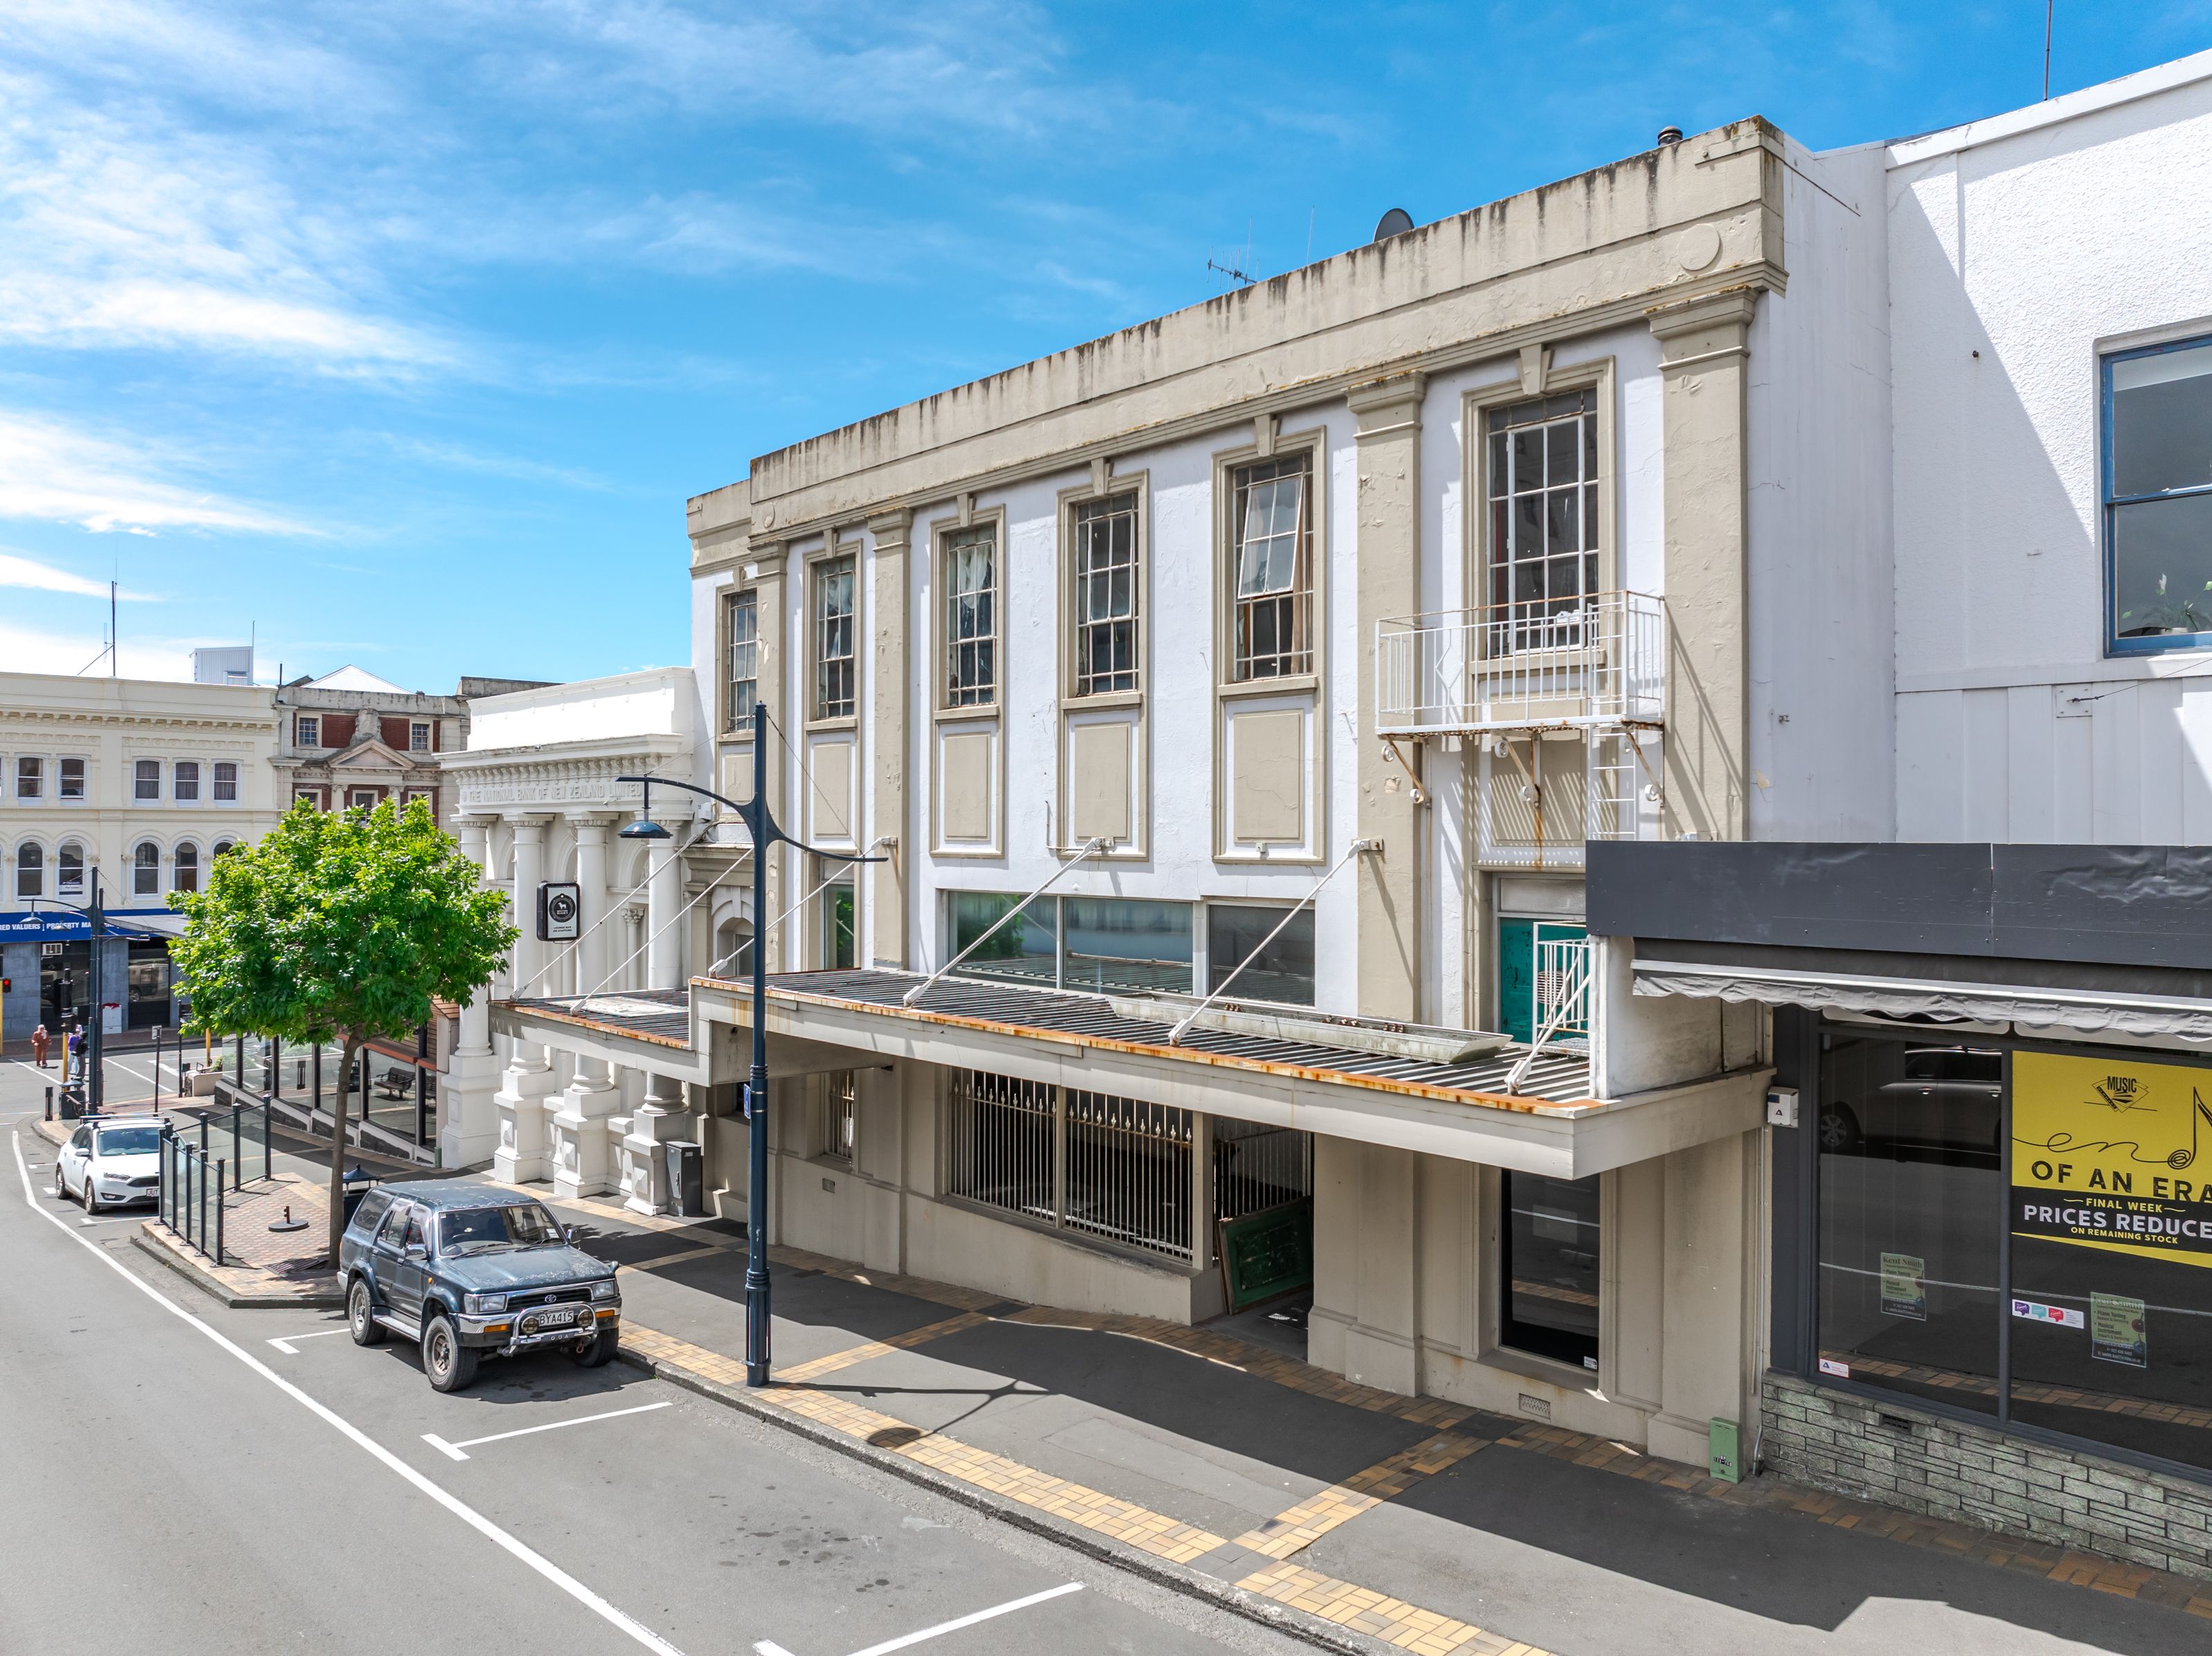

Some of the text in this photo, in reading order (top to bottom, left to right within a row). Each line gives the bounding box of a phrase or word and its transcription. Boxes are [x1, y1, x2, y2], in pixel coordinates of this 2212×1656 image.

[469, 782, 642, 802] THE NATIONAL BANK OF NEW ZEALAND LIMITED
[2107, 1075, 2137, 1093] MUSIC
[2031, 1160, 2073, 1184] OF
[2088, 1168, 2132, 1194] AN
[2086, 1198, 2163, 1213] FINAL WEEK
[2024, 1205, 2107, 1227] PRICES
[2088, 1227, 2141, 1241] REMAINING
[2144, 1234, 2178, 1244] STOCK
[539, 1311, 573, 1325] BYA415
